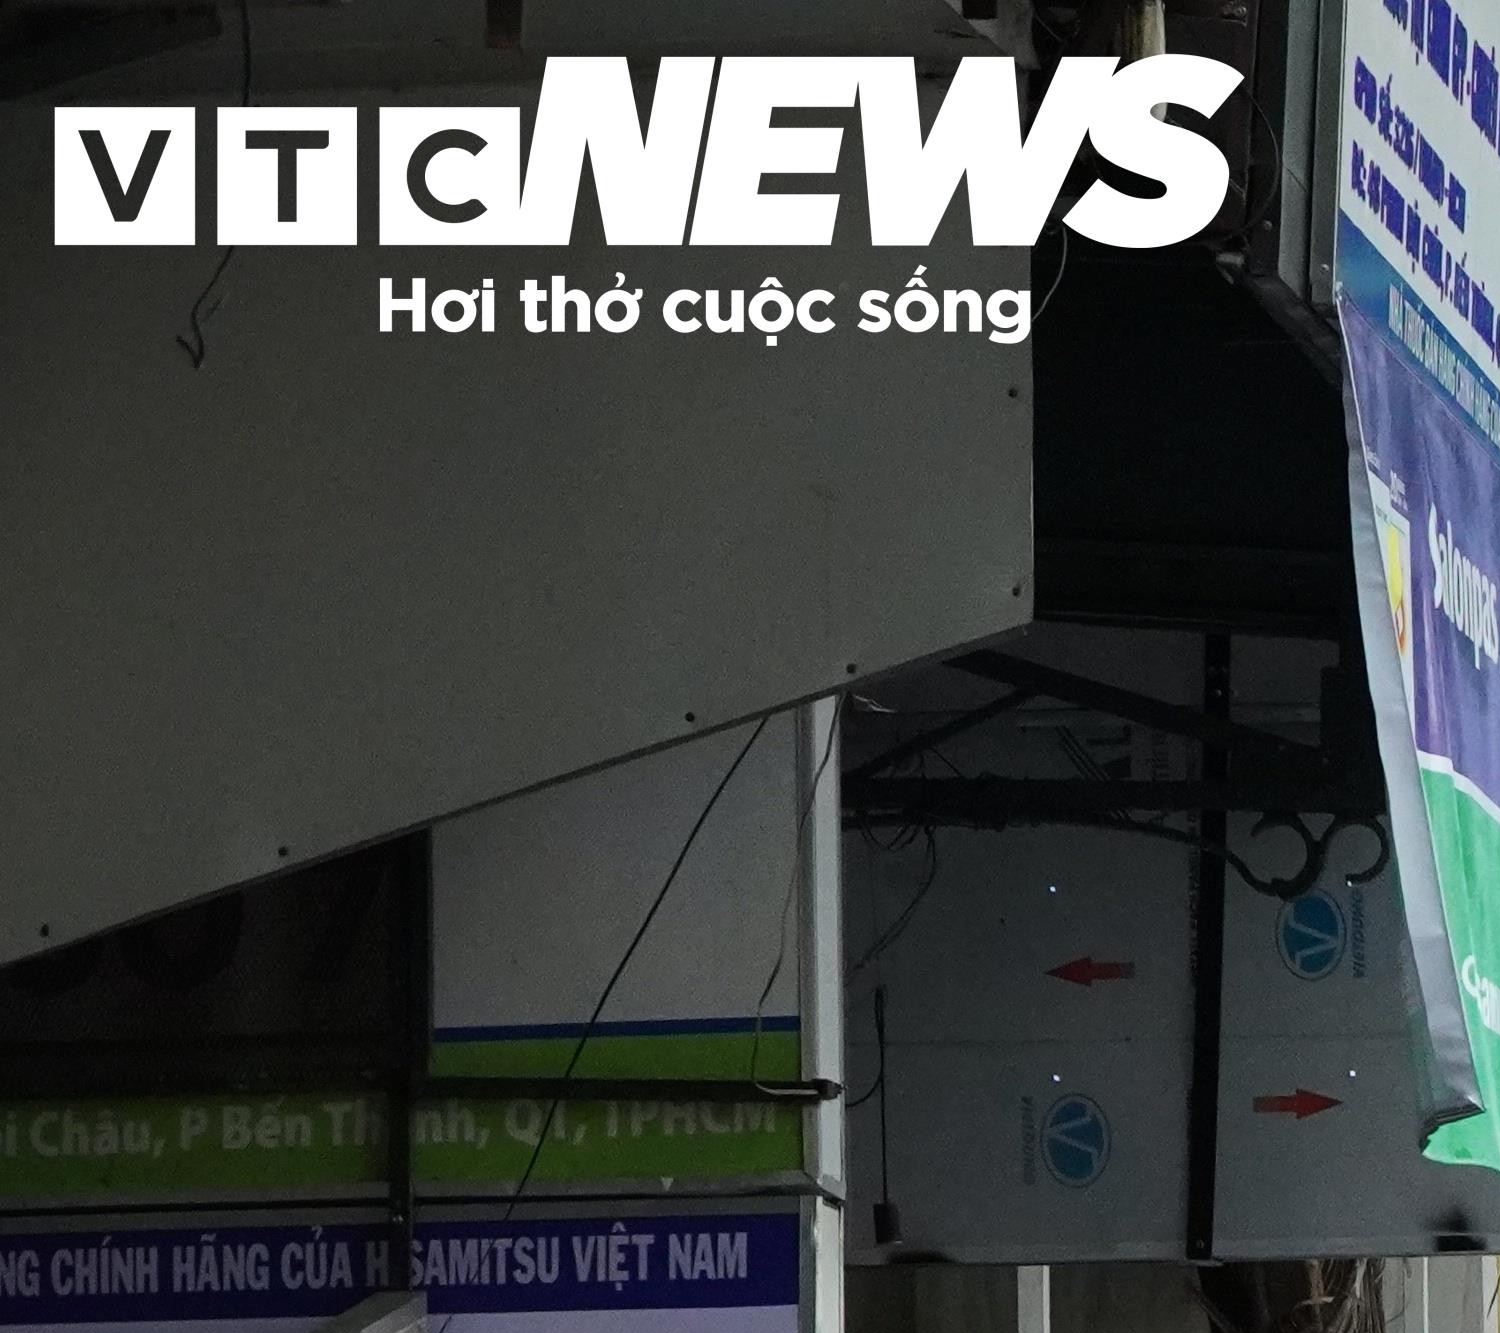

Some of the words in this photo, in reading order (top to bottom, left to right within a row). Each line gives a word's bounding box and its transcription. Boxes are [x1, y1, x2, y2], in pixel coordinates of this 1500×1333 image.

[1428, 502, 1499, 670] Salonpas
[179, 1112, 211, 1151] P
[222, 1098, 311, 1150] Bến
[330, 1098, 491, 1153] Thnh,
[51, 1233, 159, 1297] CHÍNH
[173, 1230, 269, 1293] HÃNG
[281, 1225, 350, 1290] CỦA
[366, 1233, 561, 1289] HSAMITSU
[573, 1222, 654, 1292] VIỆT
[668, 1231, 748, 1283] NAM
